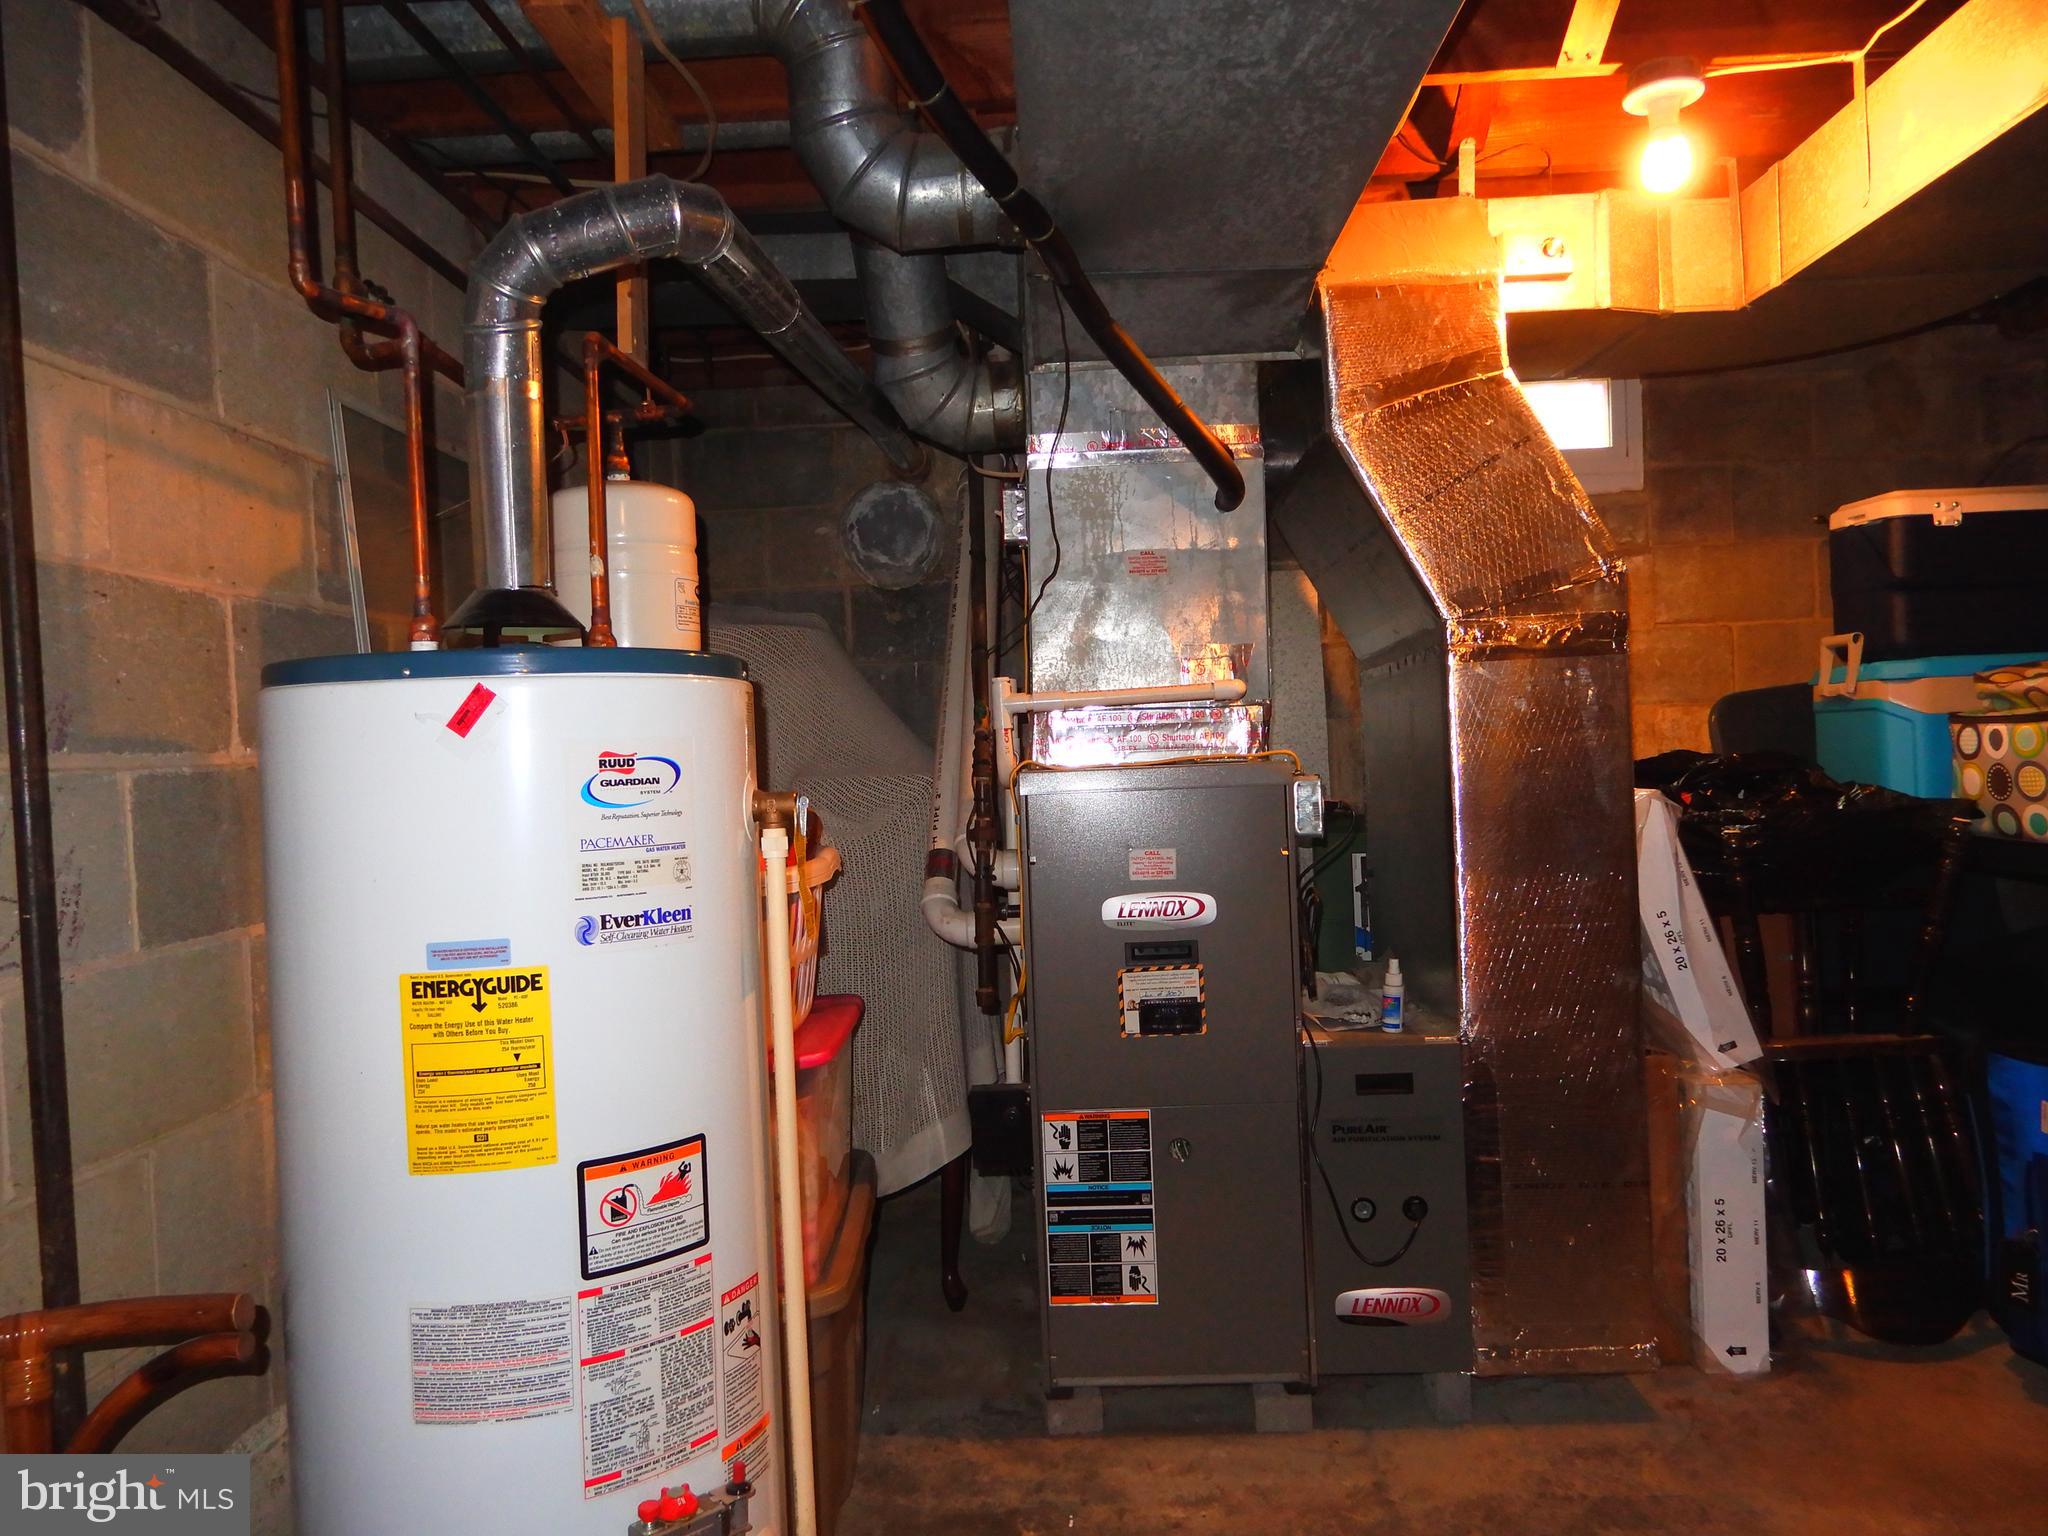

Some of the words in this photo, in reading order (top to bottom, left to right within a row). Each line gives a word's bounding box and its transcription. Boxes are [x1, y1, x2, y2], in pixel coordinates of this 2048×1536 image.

[1161, 732, 1196, 742] Shurtape
[598, 757, 636, 769] RUUD
[599, 776, 661, 788] GUARDIAN
[579, 833, 656, 850] PACEMAKER
[655, 845, 671, 853] WATER
[670, 843, 687, 851] HEATER
[1117, 899, 1188, 919] LENNOX
[1656, 910, 1667, 919] 5
[600, 906, 692, 931] EverKleen
[600, 930, 650, 944] Self-Cleaning
[649, 927, 669, 936] Water
[1664, 930, 1677, 945] 26
[1675, 956, 1689, 971] 20
[411, 973, 544, 1002] ENERGYGUIDE
[409, 1022, 433, 1031] Compare
[433, 1021, 443, 1030] the
[444, 1020, 464, 1030] Energy
[464, 1020, 476, 1029] Use
[476, 1020, 483, 1028] of
[483, 1018, 495, 1027] this
[496, 1017, 514, 1026] Water
[514, 1015, 535, 1025] Heater
[433, 1029, 445, 1038] with
[445, 1029, 464, 1038] Others
[465, 1028, 485, 1037] Before
[485, 1027, 497, 1036] You
[497, 1026, 511, 1036] Buy.
[631, 1152, 676, 1170] WARNING
[1714, 1198, 1725, 1207] 5
[1716, 1208, 1726, 1217] x
[615, 1230, 627, 1238] FIRE
[627, 1227, 639, 1236] AND
[638, 1221, 665, 1234] EXPLOSION
[1714, 1219, 1726, 1235] 26
[621, 1234, 635, 1243] result
[641, 1230, 657, 1239] serious
[1717, 1237, 1727, 1246] x
[1715, 1247, 1726, 1263] 20
[609, 1284, 619, 1292] FOR
[619, 1282, 632, 1290] YOUR
[631, 1277, 648, 1287] SAFETY
[647, 1274, 659, 1282] READ
[658, 1269, 674, 1279] BEFORE
[731, 1275, 758, 1299] DANGER
[1351, 1297, 1424, 1314] LENNOX
[632, 1465, 645, 1474] TURN
[643, 1462, 653, 1470] OFF
[652, 1459, 661, 1467] GAS
[666, 1447, 688, 1462] APPLIANCE
